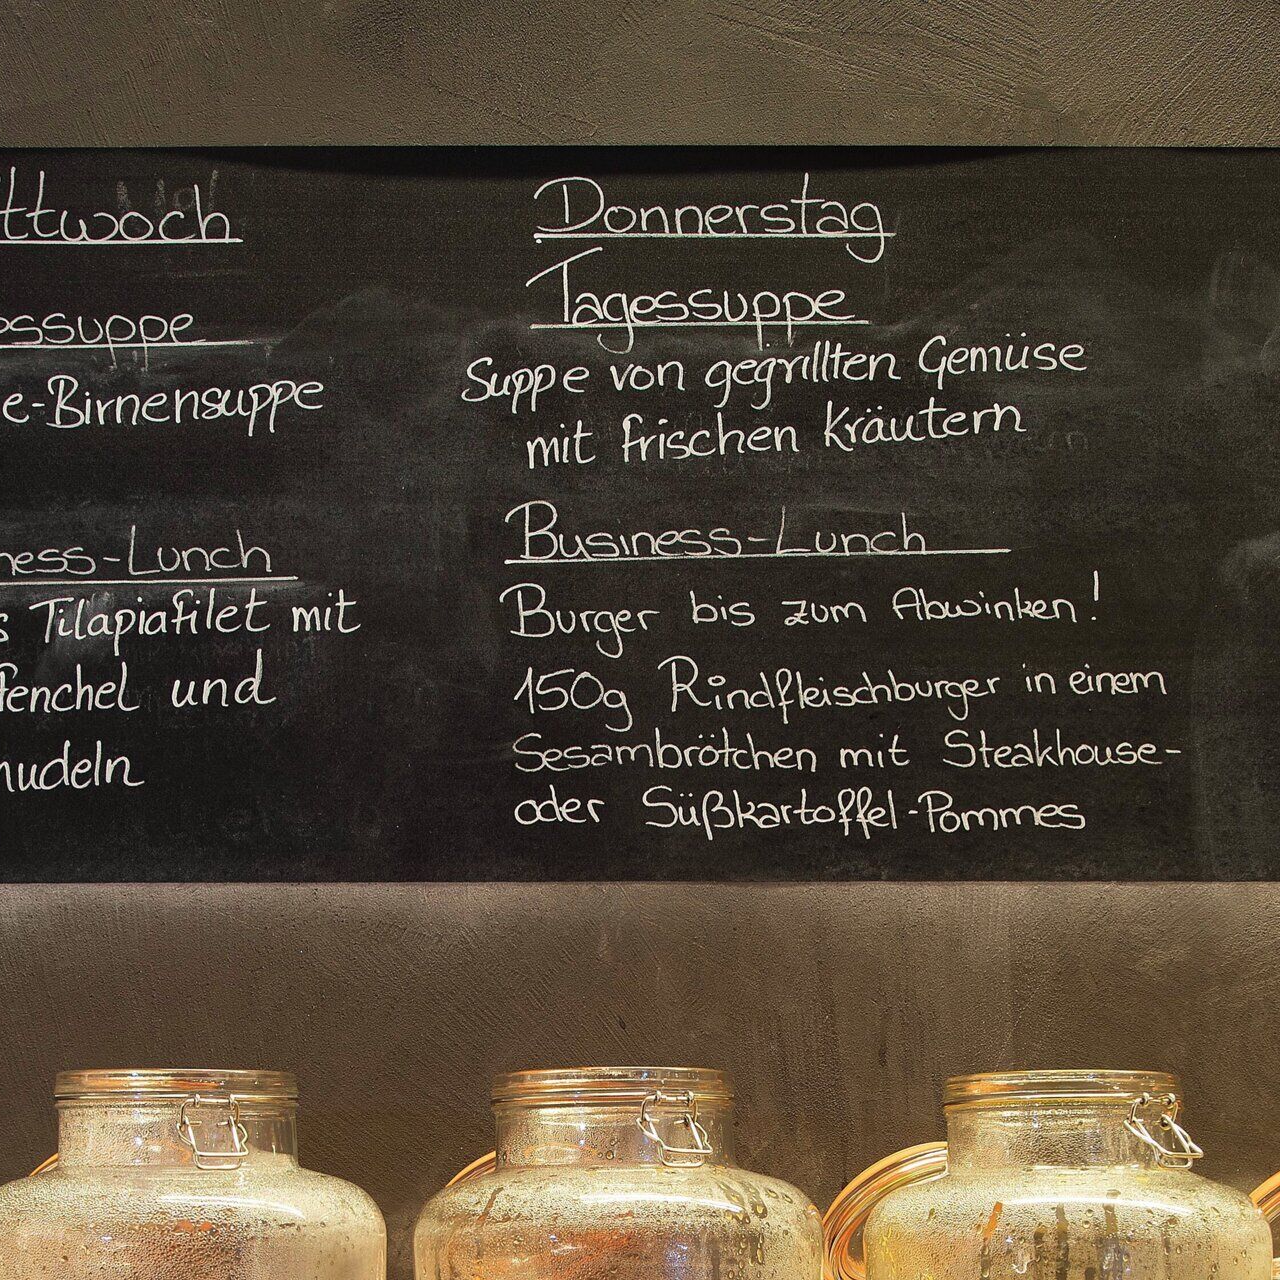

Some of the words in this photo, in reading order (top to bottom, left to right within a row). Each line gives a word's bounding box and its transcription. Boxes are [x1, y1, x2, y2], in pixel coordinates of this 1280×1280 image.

[533, 172, 887, 263] Donnerstag
[526, 247, 856, 353] Tagessuppe
[461, 357, 591, 414] Suppe
[609, 358, 686, 393] von
[704, 341, 902, 410] gegrillten
[918, 333, 1089, 375] Gemüse
[526, 421, 596, 470] mit
[622, 412, 800, 463] frischen
[823, 397, 1028, 451] Kräutern
[504, 500, 927, 560] Business-Lunch
[29, 588, 276, 656] Tilapiafilet
[292, 593, 362, 636] mit
[499, 582, 661, 657] Burger
[689, 590, 757, 628] bis
[783, 597, 868, 627] zum
[170, 648, 277, 709] und
[513, 665, 634, 732] 150g
[657, 654, 1003, 725] Rindfleischburger
[1021, 662, 1057, 697] in
[1068, 661, 1169, 697] einem
[512, 727, 818, 773] Sesambrötchen
[839, 732, 910, 769] mit
[942, 728, 1183, 768] Steakhouse-
[513, 785, 606, 826] oder
[642, 784, 1086, 841] Süßkartoffel-Pommes
